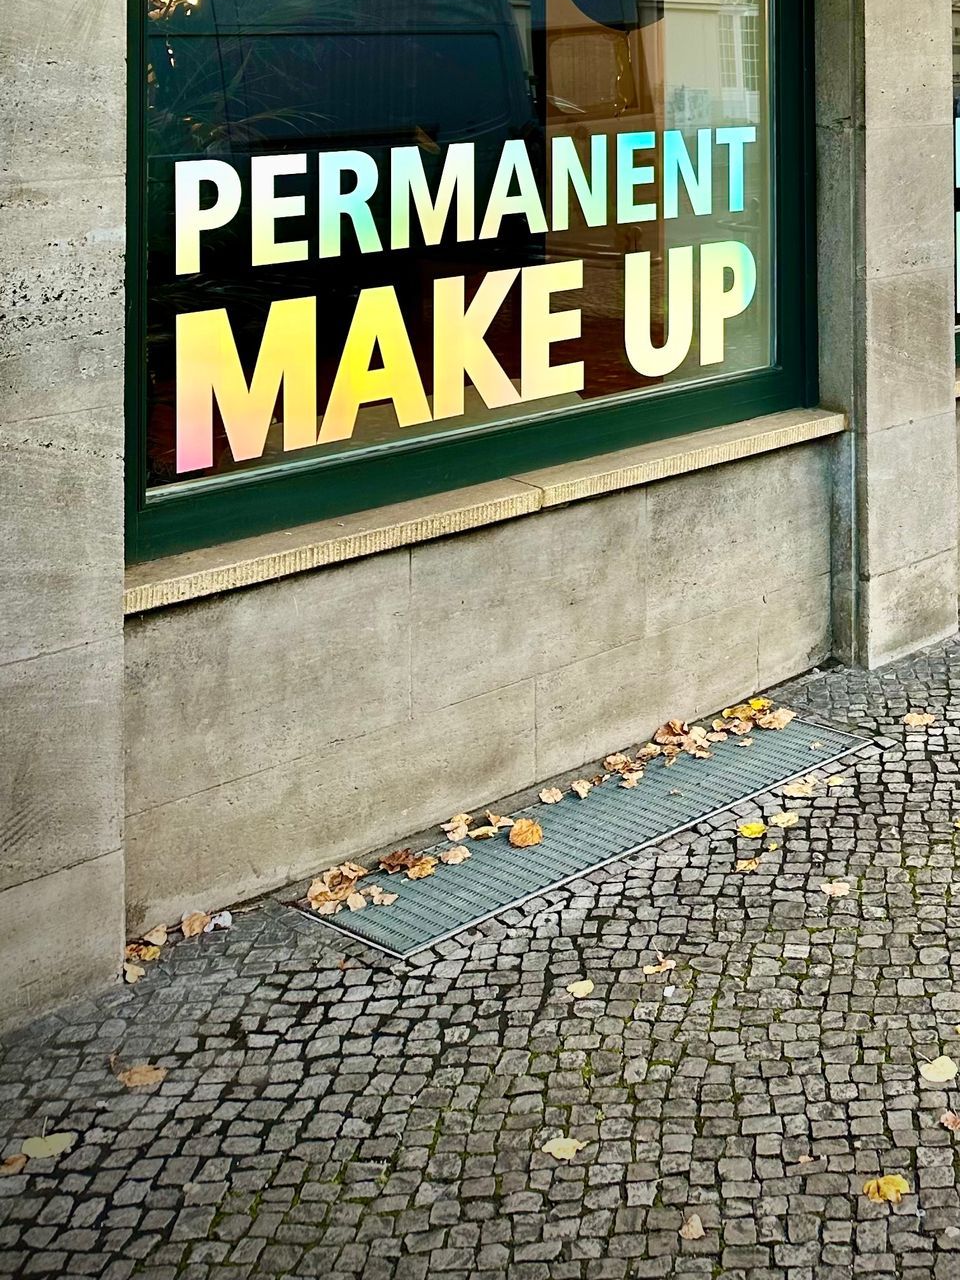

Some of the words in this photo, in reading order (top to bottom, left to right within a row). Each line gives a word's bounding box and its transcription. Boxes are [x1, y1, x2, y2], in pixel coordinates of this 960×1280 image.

[174, 126, 756, 276] PERMANENT
[175, 260, 585, 475] MAKE
[624, 239, 757, 378] UP
